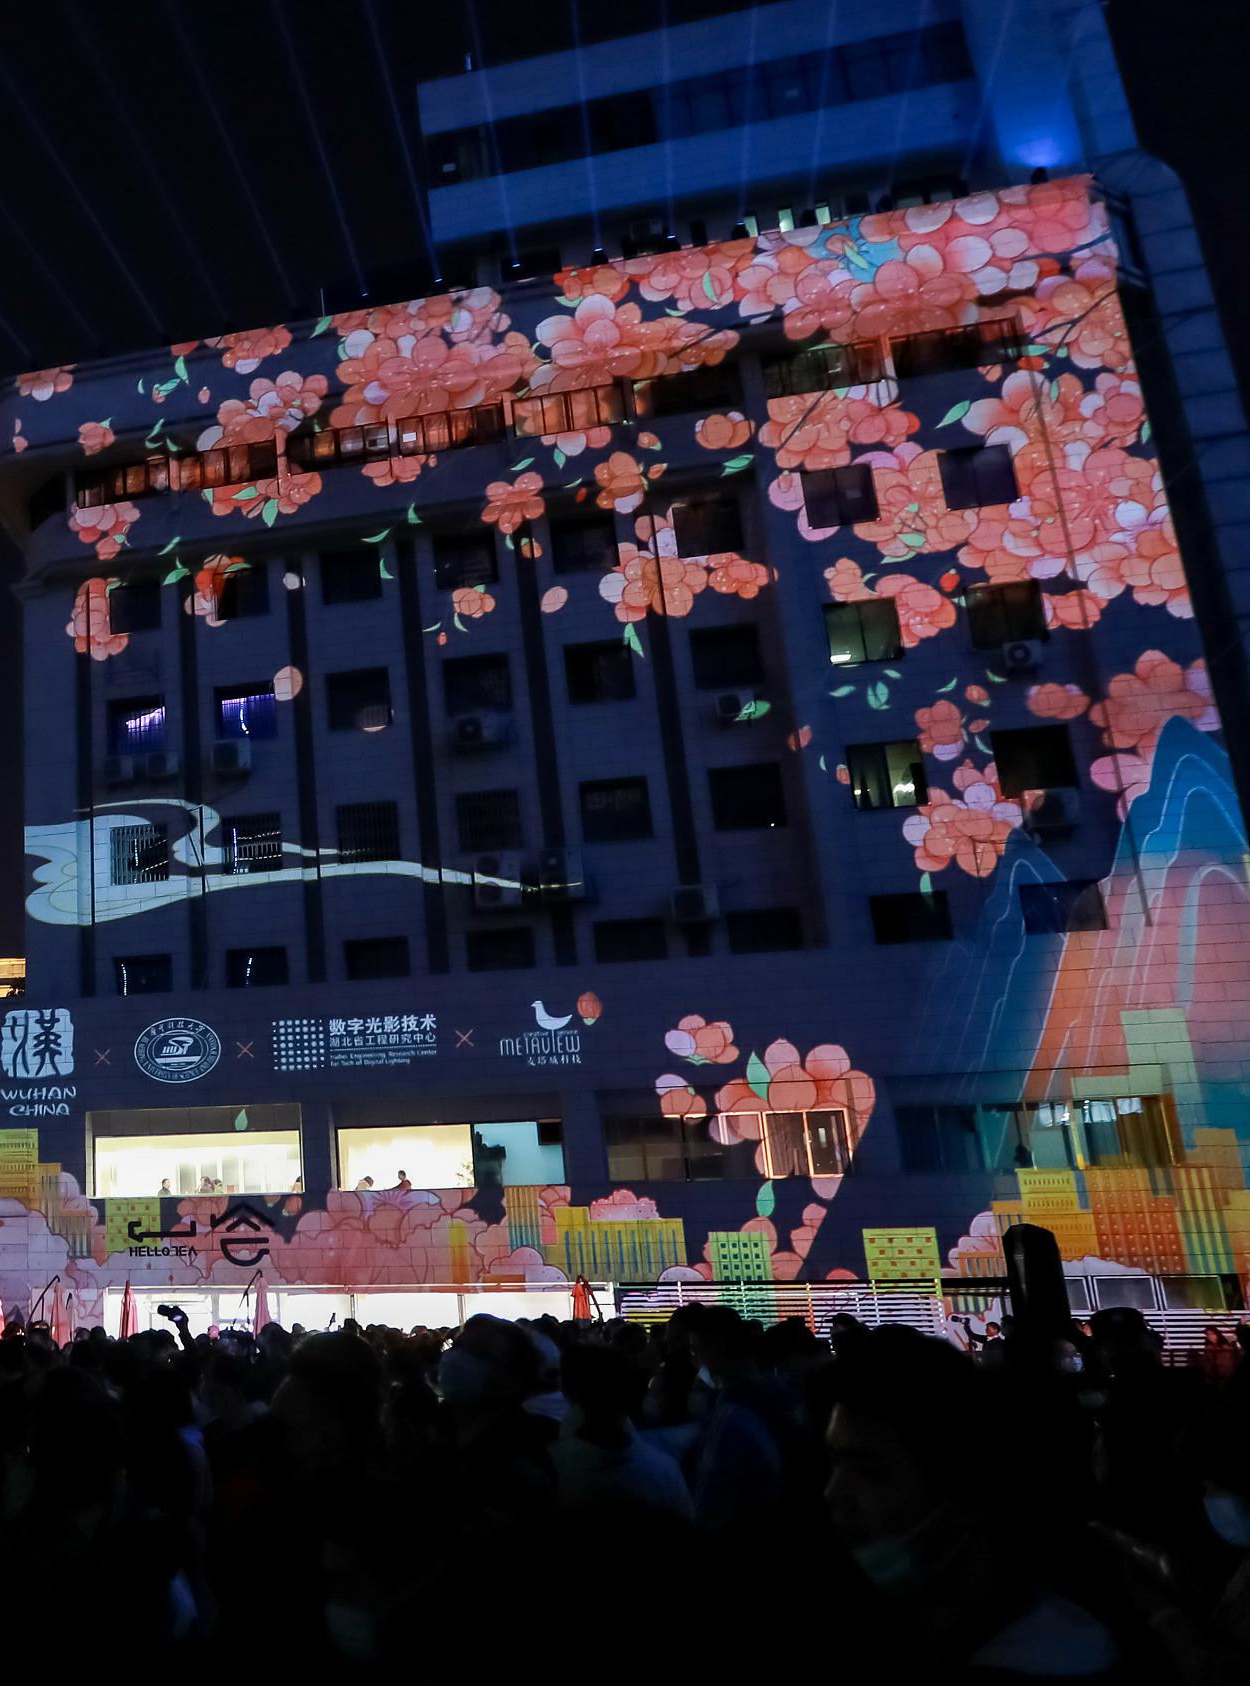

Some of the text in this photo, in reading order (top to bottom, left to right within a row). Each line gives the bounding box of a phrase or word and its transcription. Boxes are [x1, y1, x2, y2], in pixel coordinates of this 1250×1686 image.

[329, 1014, 437, 1036] 数字光影技术
[330, 1032, 436, 1047] 湖北省工程研究中心
[0, 1086, 77, 1100] WUHAN
[9, 1102, 70, 1116] CHINA
